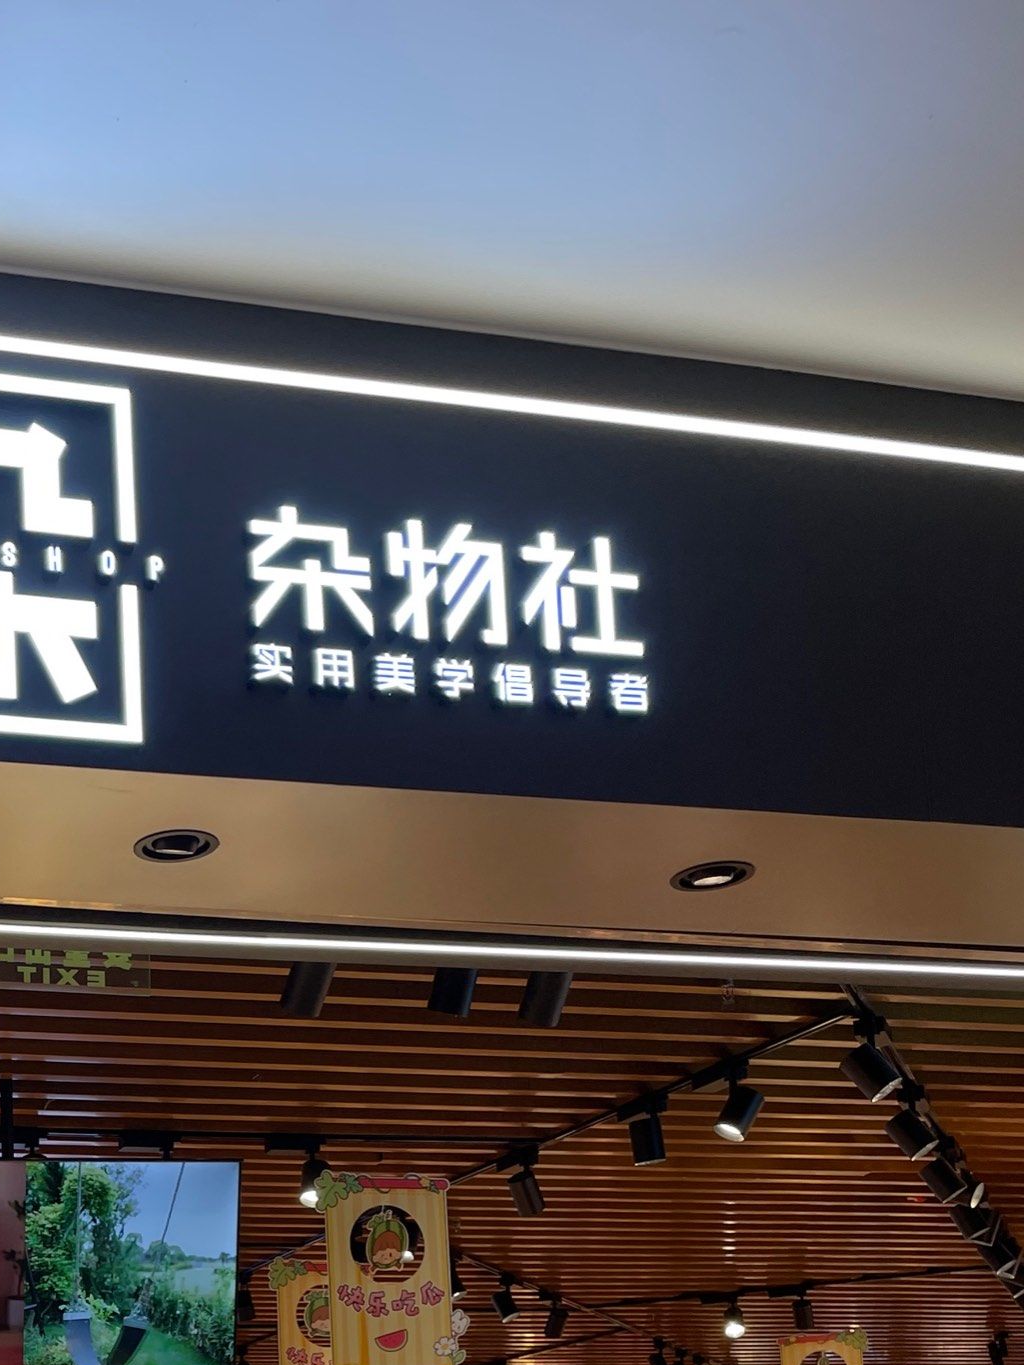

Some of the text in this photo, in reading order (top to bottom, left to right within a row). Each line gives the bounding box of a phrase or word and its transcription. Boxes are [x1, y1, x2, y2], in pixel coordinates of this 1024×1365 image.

[0, 540, 165, 582] SHOP
[247, 504, 646, 658] 杂物社
[251, 643, 651, 714] 实用美学倡导者
[337, 1280, 445, 1318] 快乐吃瓜
